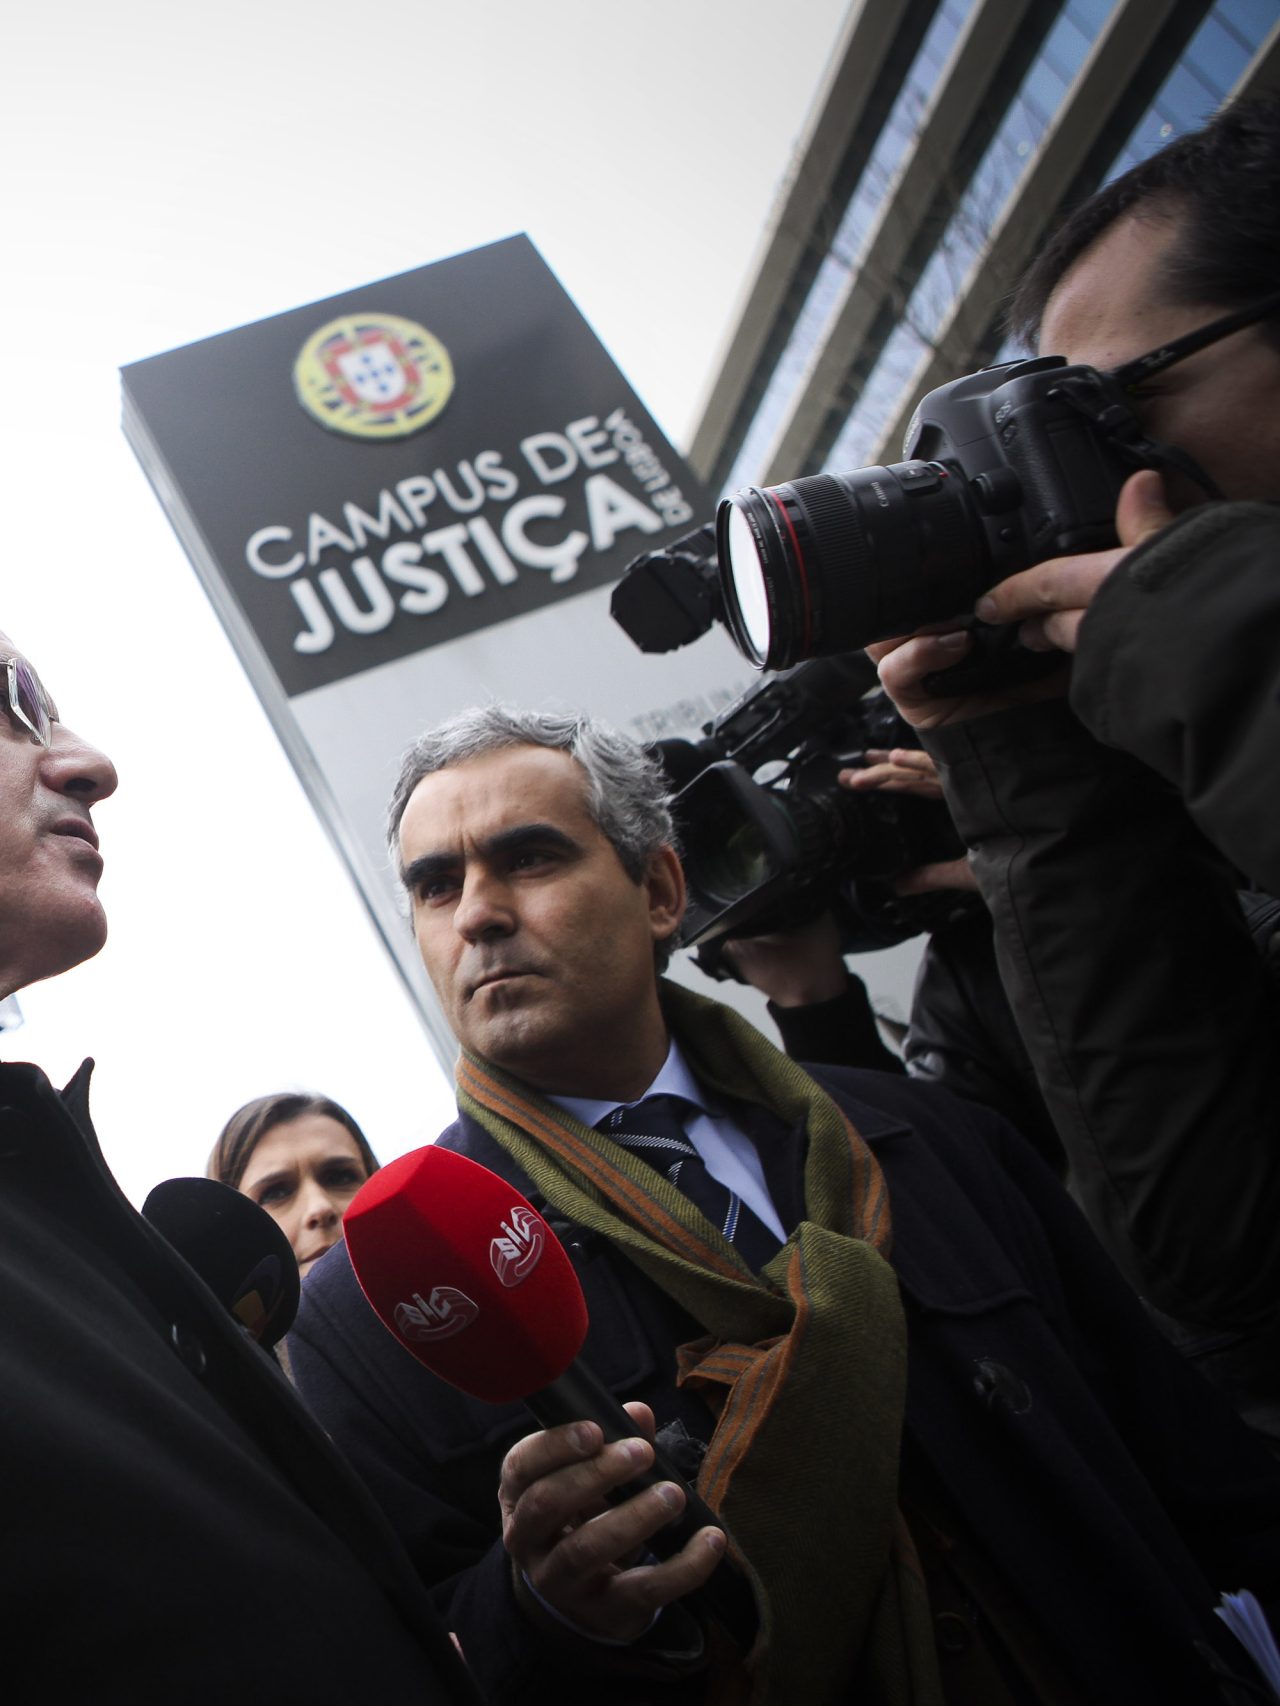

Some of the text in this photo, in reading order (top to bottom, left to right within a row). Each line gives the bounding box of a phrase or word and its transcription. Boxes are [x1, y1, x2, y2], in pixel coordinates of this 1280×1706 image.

[246, 416, 619, 579] CAMPUS DE
[289, 473, 664, 654] JUSTIÇA
